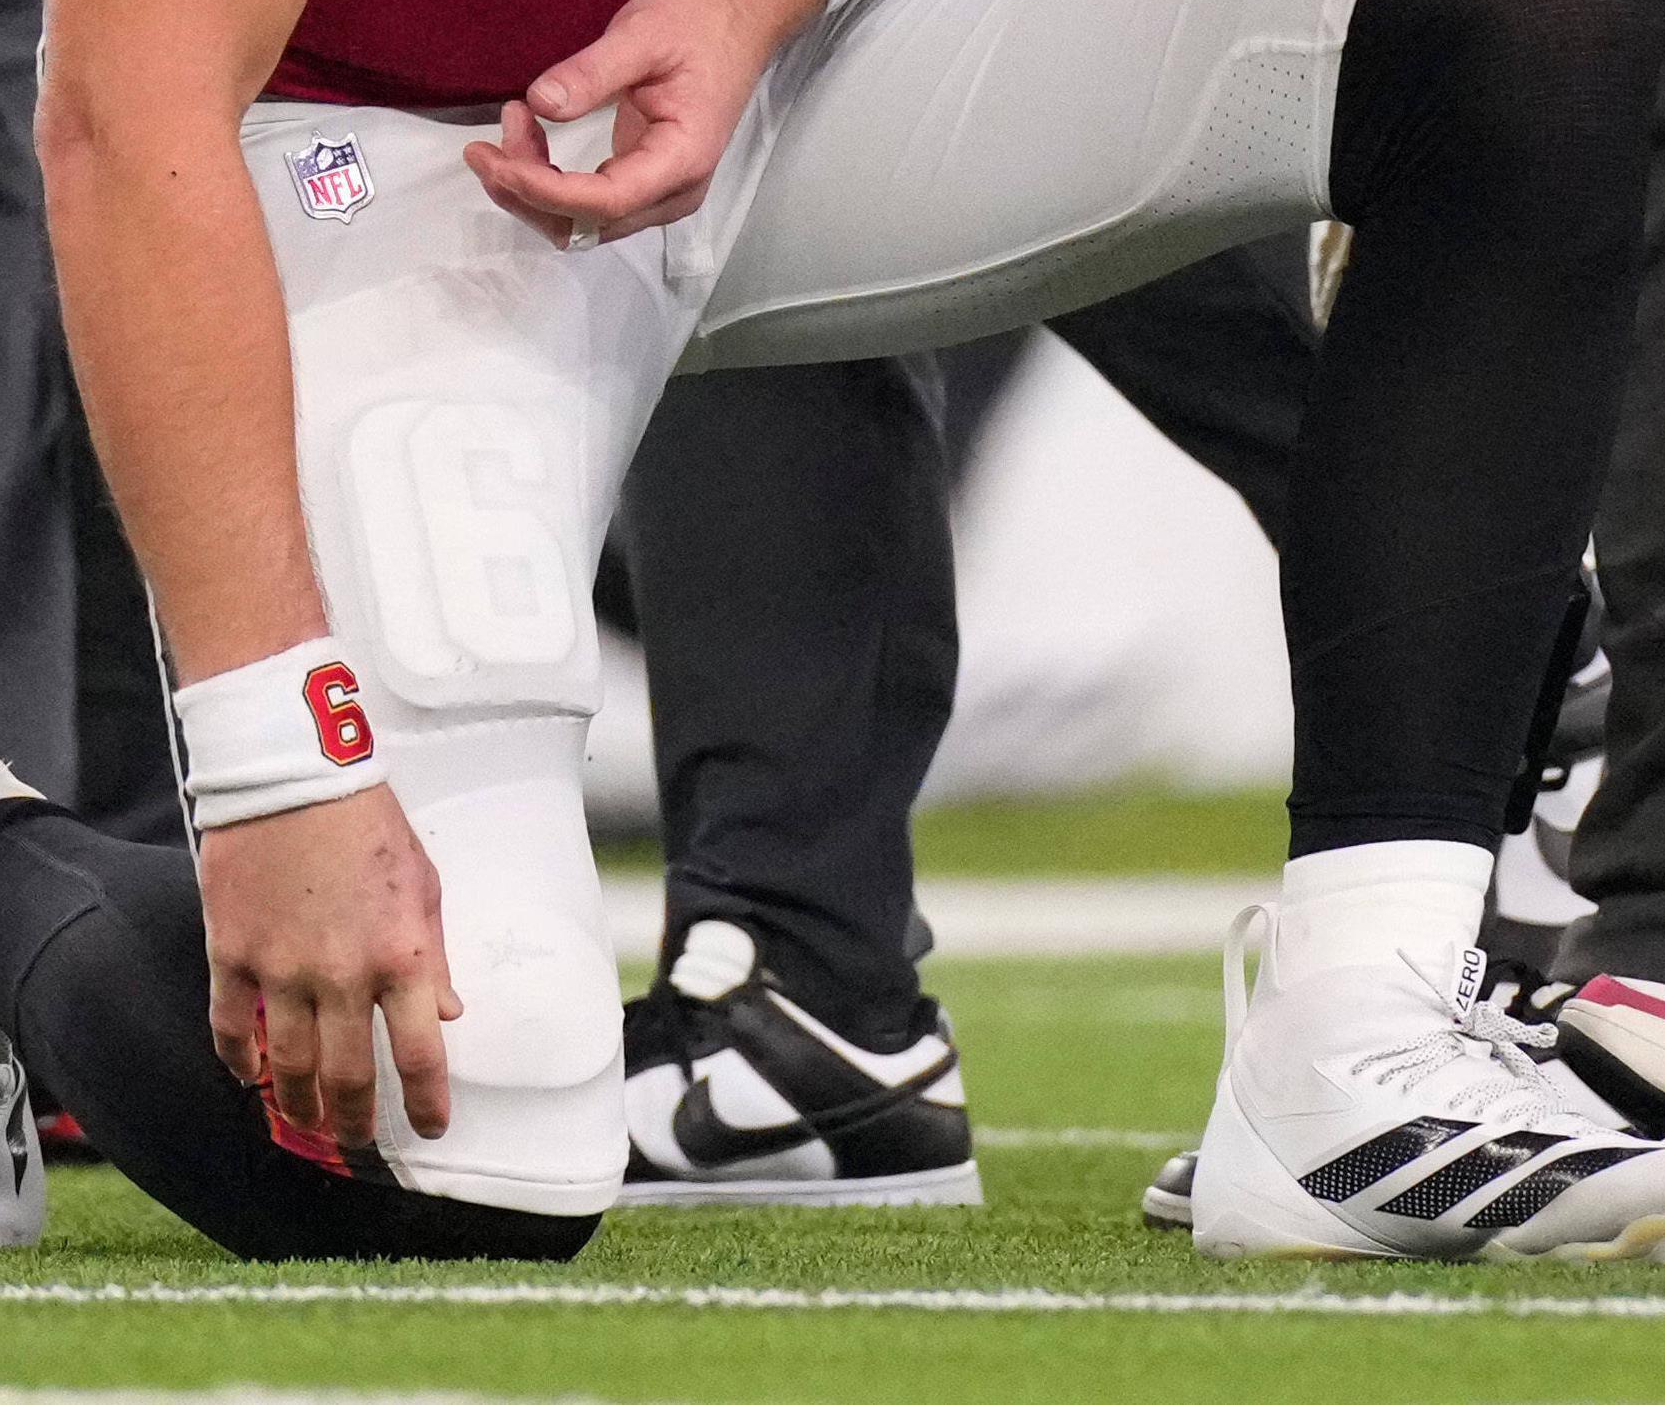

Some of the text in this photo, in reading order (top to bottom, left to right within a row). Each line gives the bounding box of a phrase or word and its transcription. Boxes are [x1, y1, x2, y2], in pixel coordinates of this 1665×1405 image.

[307, 168, 363, 207] NFL
[301, 660, 374, 768] 6
[1455, 949, 1481, 1012] ZERO
